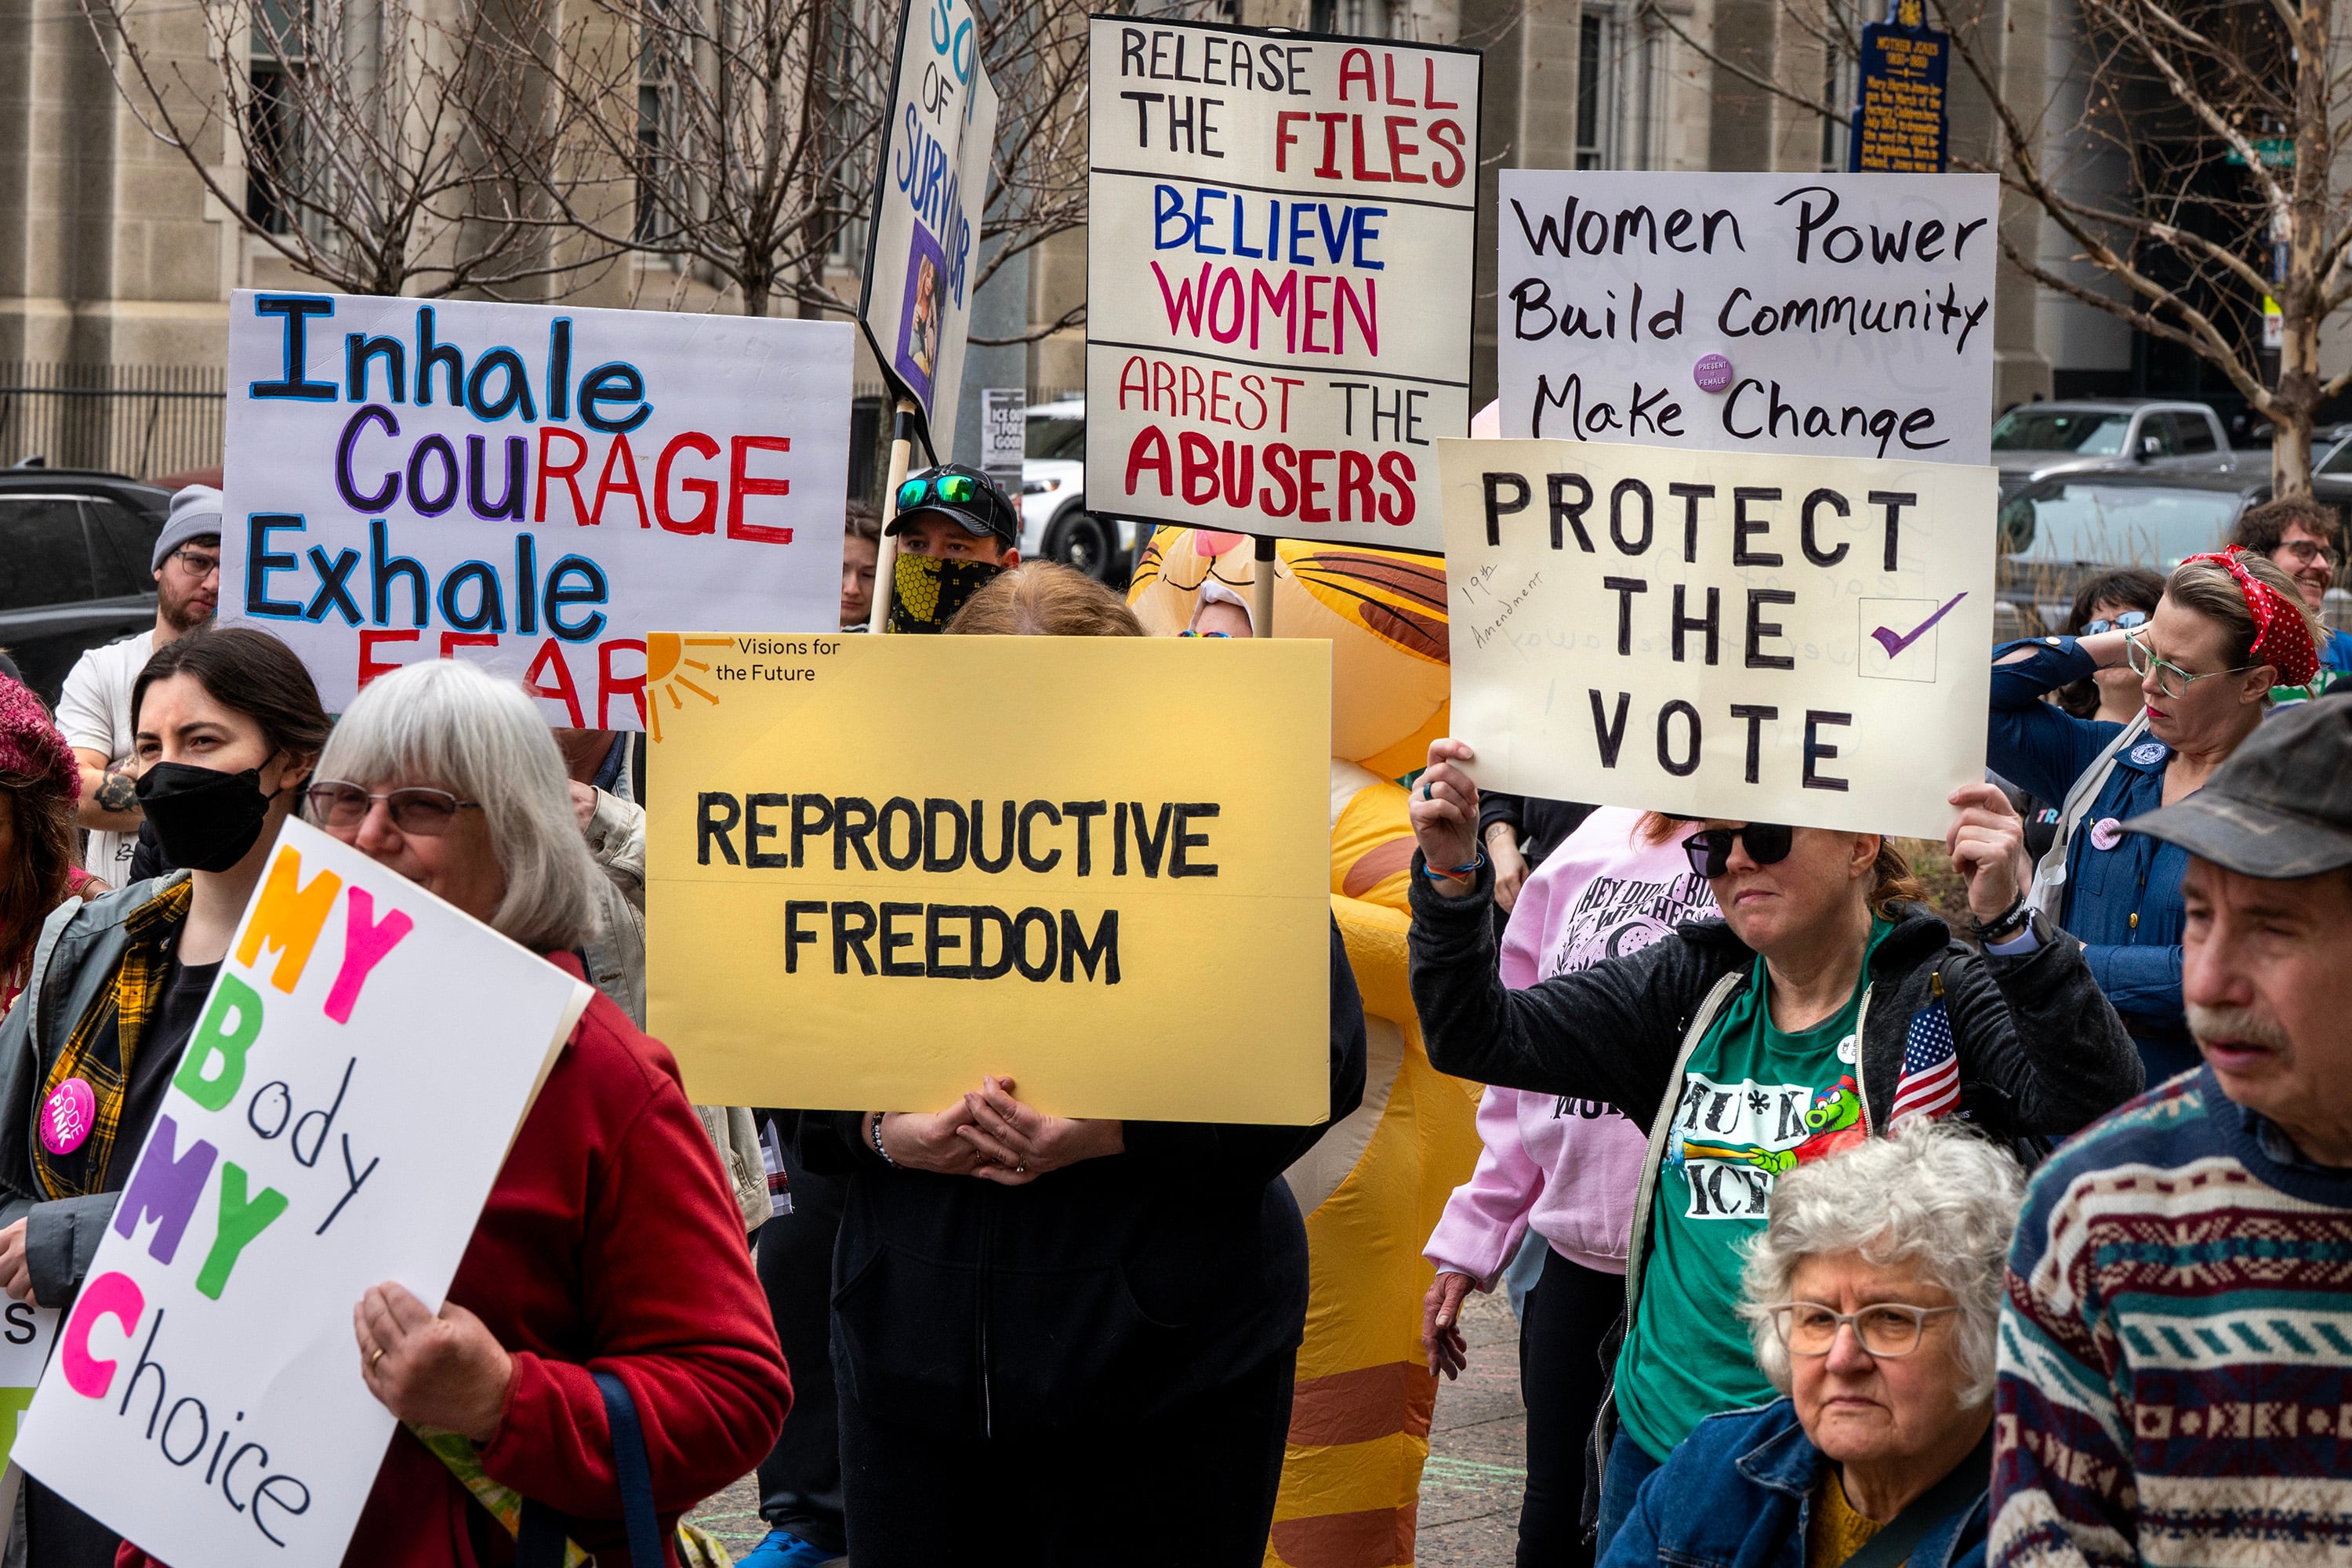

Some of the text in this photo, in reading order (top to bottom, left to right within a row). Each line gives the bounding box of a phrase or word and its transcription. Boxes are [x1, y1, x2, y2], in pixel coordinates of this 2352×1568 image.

[923, 60, 953, 125] OF
[1121, 27, 1458, 110] RELEASE ALL
[1120, 91, 1465, 188] THE FILES
[1154, 184, 1388, 270] BELIEVE
[1510, 187, 1987, 265] Women Power
[1150, 260, 1378, 357] WOMEN
[1508, 277, 1989, 354] Build Community
[249, 294, 654, 433] Inhale
[1120, 355, 1429, 445] ARREST THE
[1698, 361, 1727, 371] PRESENT
[1699, 376, 1726, 387] FEMALE
[1532, 372, 1951, 459] Make Change
[1125, 424, 1416, 526] ABUSERS
[1482, 471, 1917, 572] PROTECT
[244, 512, 609, 644] Exhale
[1461, 564, 1498, 605] 19th
[1471, 571, 1543, 650] Amendment
[739, 637, 841, 655] Visions for
[1603, 576, 1796, 670] THE
[716, 664, 815, 681] the Future
[1588, 688, 1852, 792] VOTE
[696, 791, 1221, 879] REPRODUCTIVE
[235, 844, 413, 1025] MY
[784, 900, 1121, 985] FREEDOM
[49, 1094, 71, 1149] PINK
[61, 1084, 84, 1140] CODE
[173, 971, 379, 1236] Body
[114, 1113, 289, 1300] MY
[62, 1271, 311, 1548] Choice
